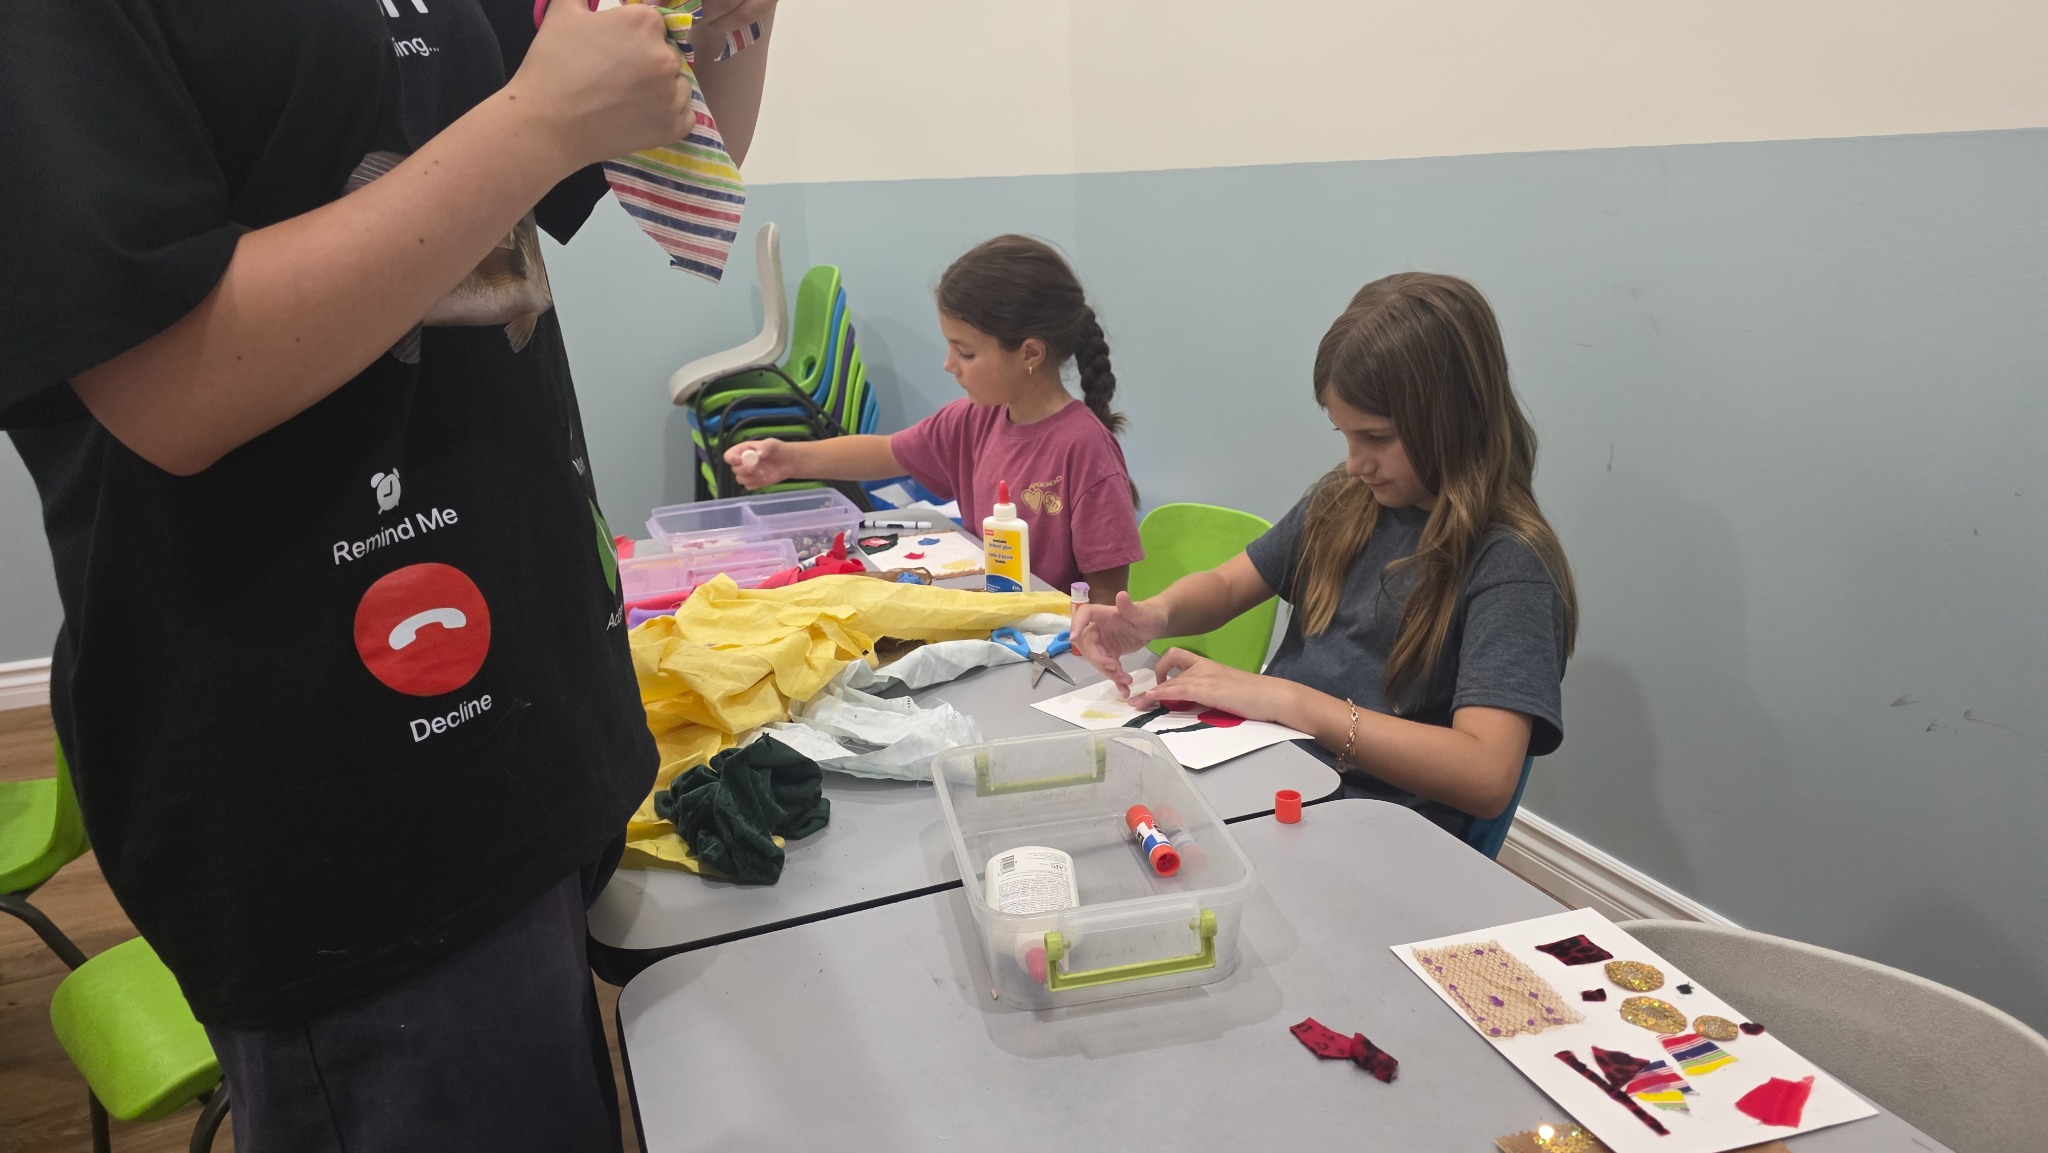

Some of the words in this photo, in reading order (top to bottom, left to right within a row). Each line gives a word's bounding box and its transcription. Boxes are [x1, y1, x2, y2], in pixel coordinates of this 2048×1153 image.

[333, 517, 416, 565] Remind
[415, 507, 459, 533] Me
[409, 694, 493, 743] Decline
